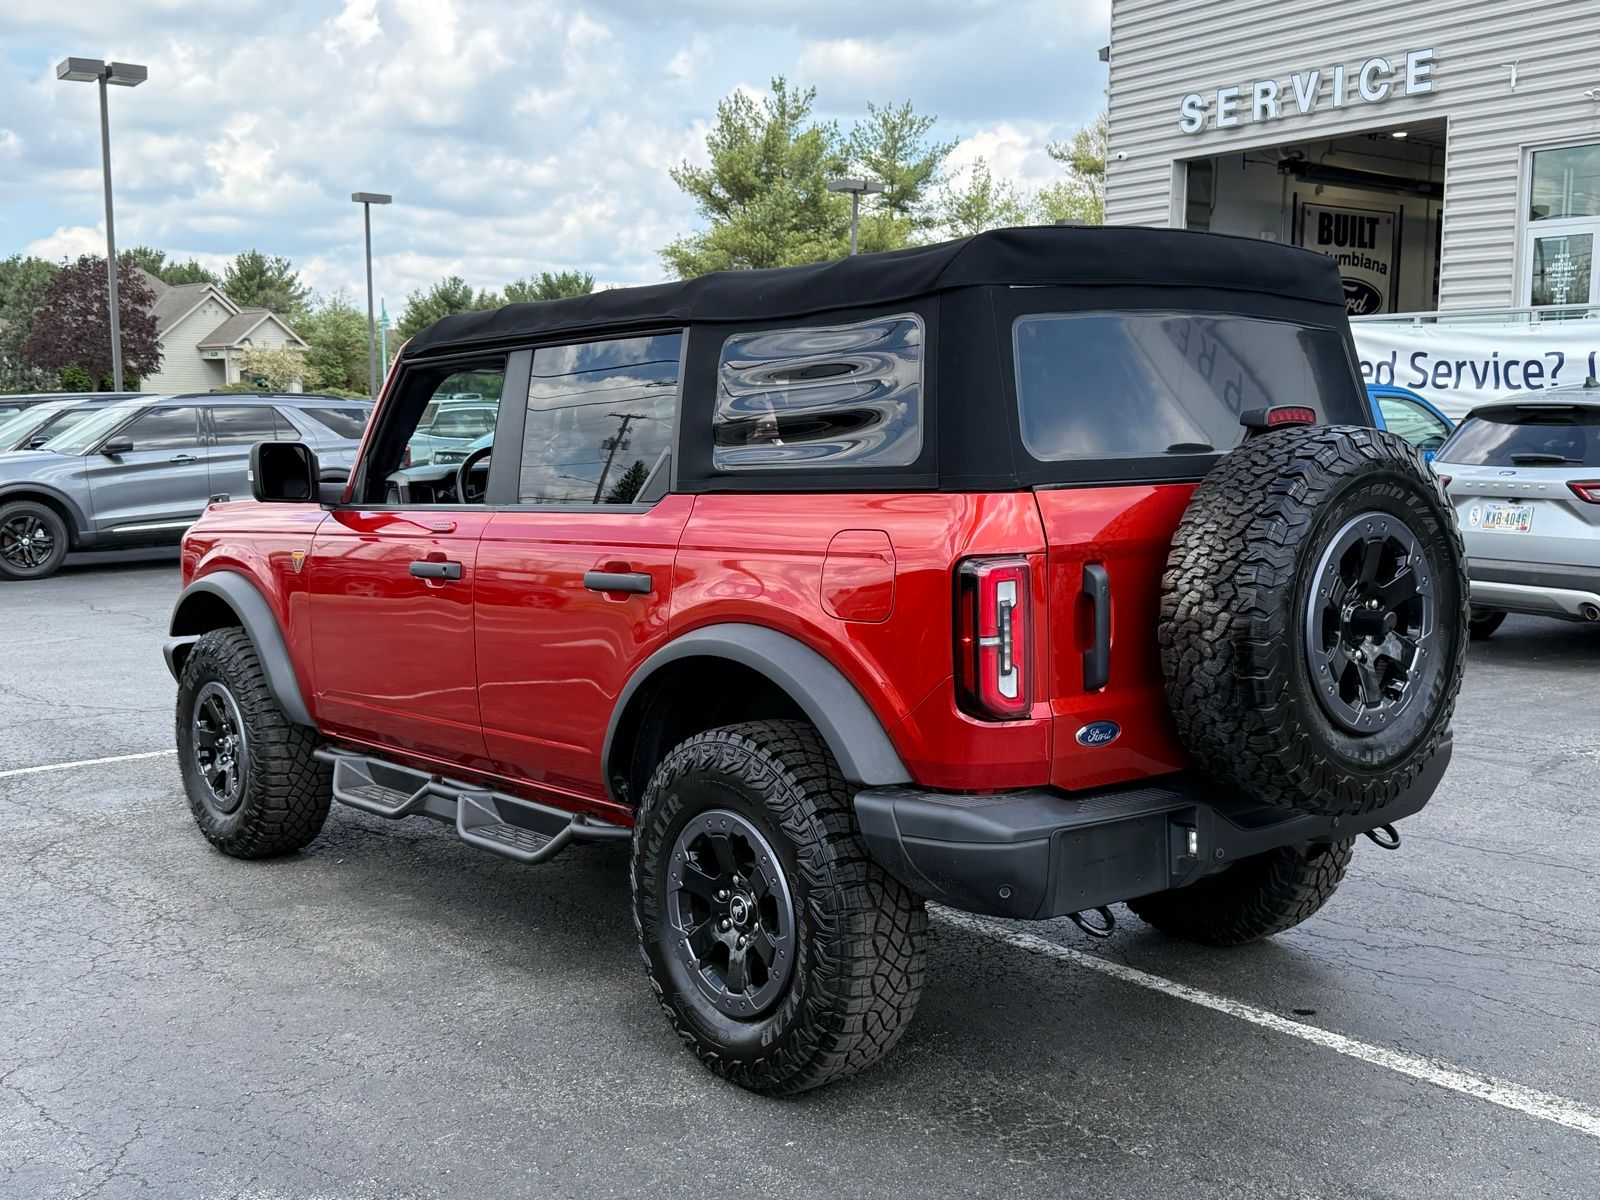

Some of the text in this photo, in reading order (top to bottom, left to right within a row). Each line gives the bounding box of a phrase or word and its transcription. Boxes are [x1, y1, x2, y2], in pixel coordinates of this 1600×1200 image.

[1179, 48, 1436, 134] SERVICE
[1317, 212, 1380, 249] BUILT
[1325, 250, 1387, 275] mbiana
[1407, 351, 1565, 389] Service?
[1087, 727, 1112, 743] Ford
[642, 792, 684, 944] WRANGLER
